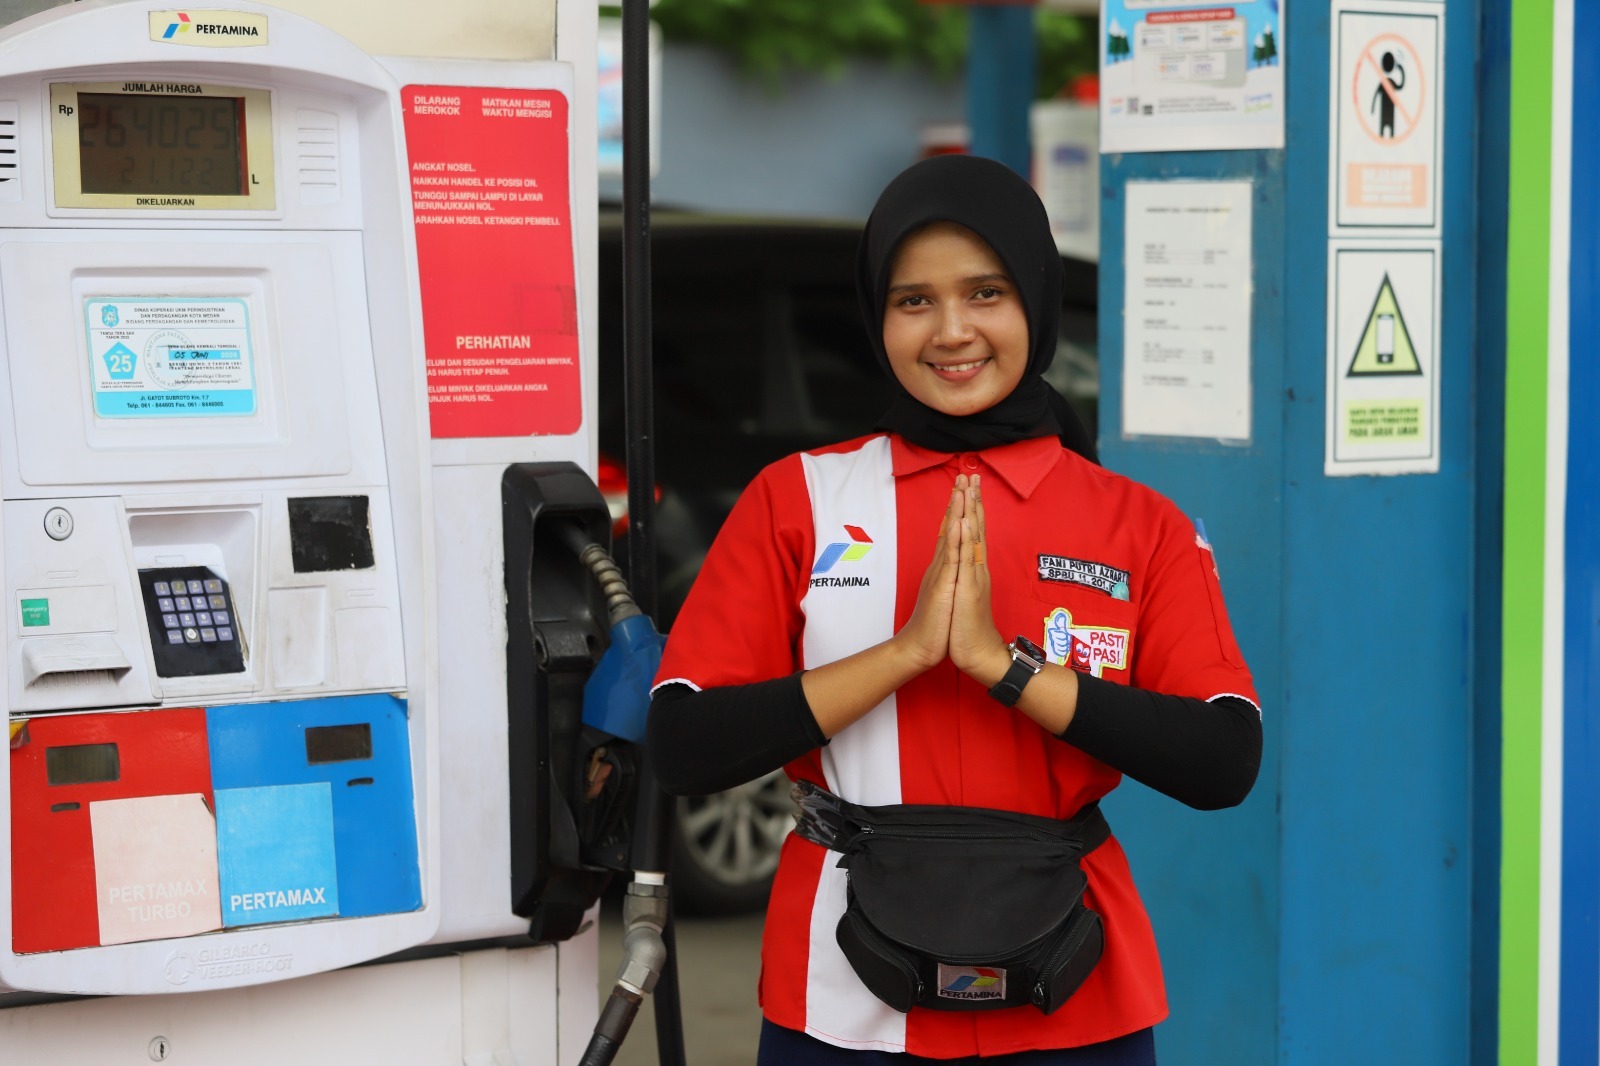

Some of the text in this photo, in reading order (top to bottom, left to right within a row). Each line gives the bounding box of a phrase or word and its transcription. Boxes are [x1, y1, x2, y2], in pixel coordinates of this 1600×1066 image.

[196, 24, 259, 36] PERTAMINA
[122, 83, 202, 94] JUMLAH HARGA
[414, 96, 461, 106] DILARANG
[482, 98, 550, 109] MATIKAN MESIN
[58, 104, 74, 116] Rp
[414, 106, 460, 115] MEROKOK
[482, 108, 552, 118] WAKTU MENGISI
[79, 103, 231, 150] 264025
[413, 163, 476, 172] ANGKAT NOSEL.
[251, 175, 259, 185] L
[413, 177, 538, 187] NAIKKAN HANDEL KE POSISI ON.
[414, 191, 543, 201] TUNGGU SAMPAI LAMPU DI LAYAR
[136, 198, 195, 206] DIKELUARKAN
[414, 201, 495, 211] MENUNJUKKAN NOL.
[415, 216, 560, 226] ARAHKAN NOSEL KETANGKI PEMBELI.
[456, 335, 531, 349] PERHATIAN
[110, 355, 132, 373] 25
[447, 358, 461, 367] DAN
[463, 358, 495, 367] SESUDAH
[496, 358, 546, 366] PENGELUARAN
[438, 368, 462, 376] HARUS
[463, 368, 484, 376] TETAP
[448, 385, 474, 393] MINYAK
[475, 384, 523, 392] DIKELUARKAN
[1042, 557, 1066, 568] FANI
[1069, 560, 1096, 575] PUTRI
[1048, 569, 1074, 580] SPBU
[809, 577, 870, 588] PERTAMINA
[1090, 631, 1124, 649] PASTI
[1093, 647, 1120, 664] PAS!
[108, 879, 208, 904] PERTAMAX
[230, 887, 326, 912] PERTAMAX
[128, 902, 191, 922] TURBO
[199, 942, 271, 962] GILBARCO
[199, 957, 294, 980] VEEDER-ROOT
[940, 989, 1002, 999] PERTAMINA
